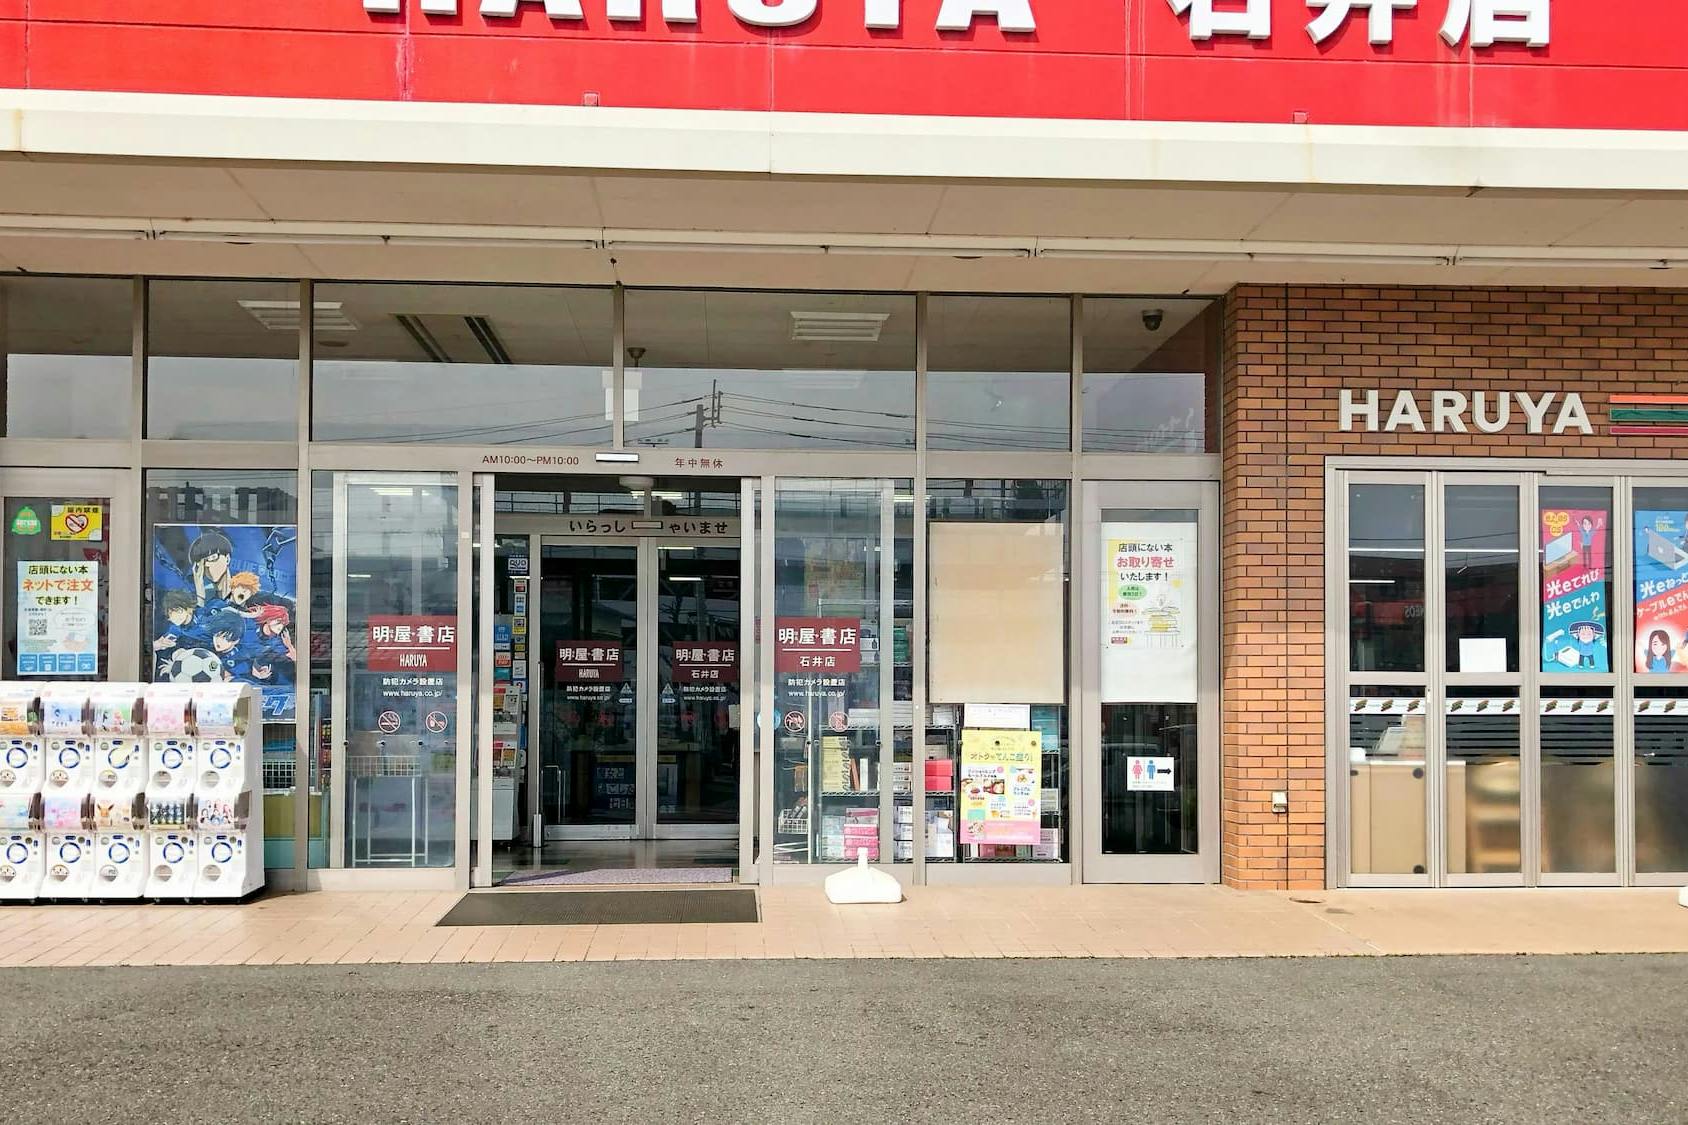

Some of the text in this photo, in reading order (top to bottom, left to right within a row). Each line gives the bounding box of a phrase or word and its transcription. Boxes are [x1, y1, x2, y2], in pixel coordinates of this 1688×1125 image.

[1338, 389, 1594, 435] HARUYA
[674, 457, 723, 469] 年中無休
[1118, 543, 1173, 553] 店頭にない本
[1116, 556, 1175, 569] お取り寄せ
[28, 565, 89, 575] 店頭にない本
[23, 579, 94, 592] ネットで注文
[1546, 568, 1600, 599] 光eてれび
[1546, 591, 1600, 620] 光eでんわ
[372, 625, 456, 643] 明屋書店
[778, 627, 857, 645] 明屋書店
[399, 654, 428, 667] HARUYA
[559, 648, 620, 662] 明屋書店
[675, 648, 735, 662] 明屋書店
[799, 655, 836, 667] 石井店
[691, 669, 720, 679] 石井店
